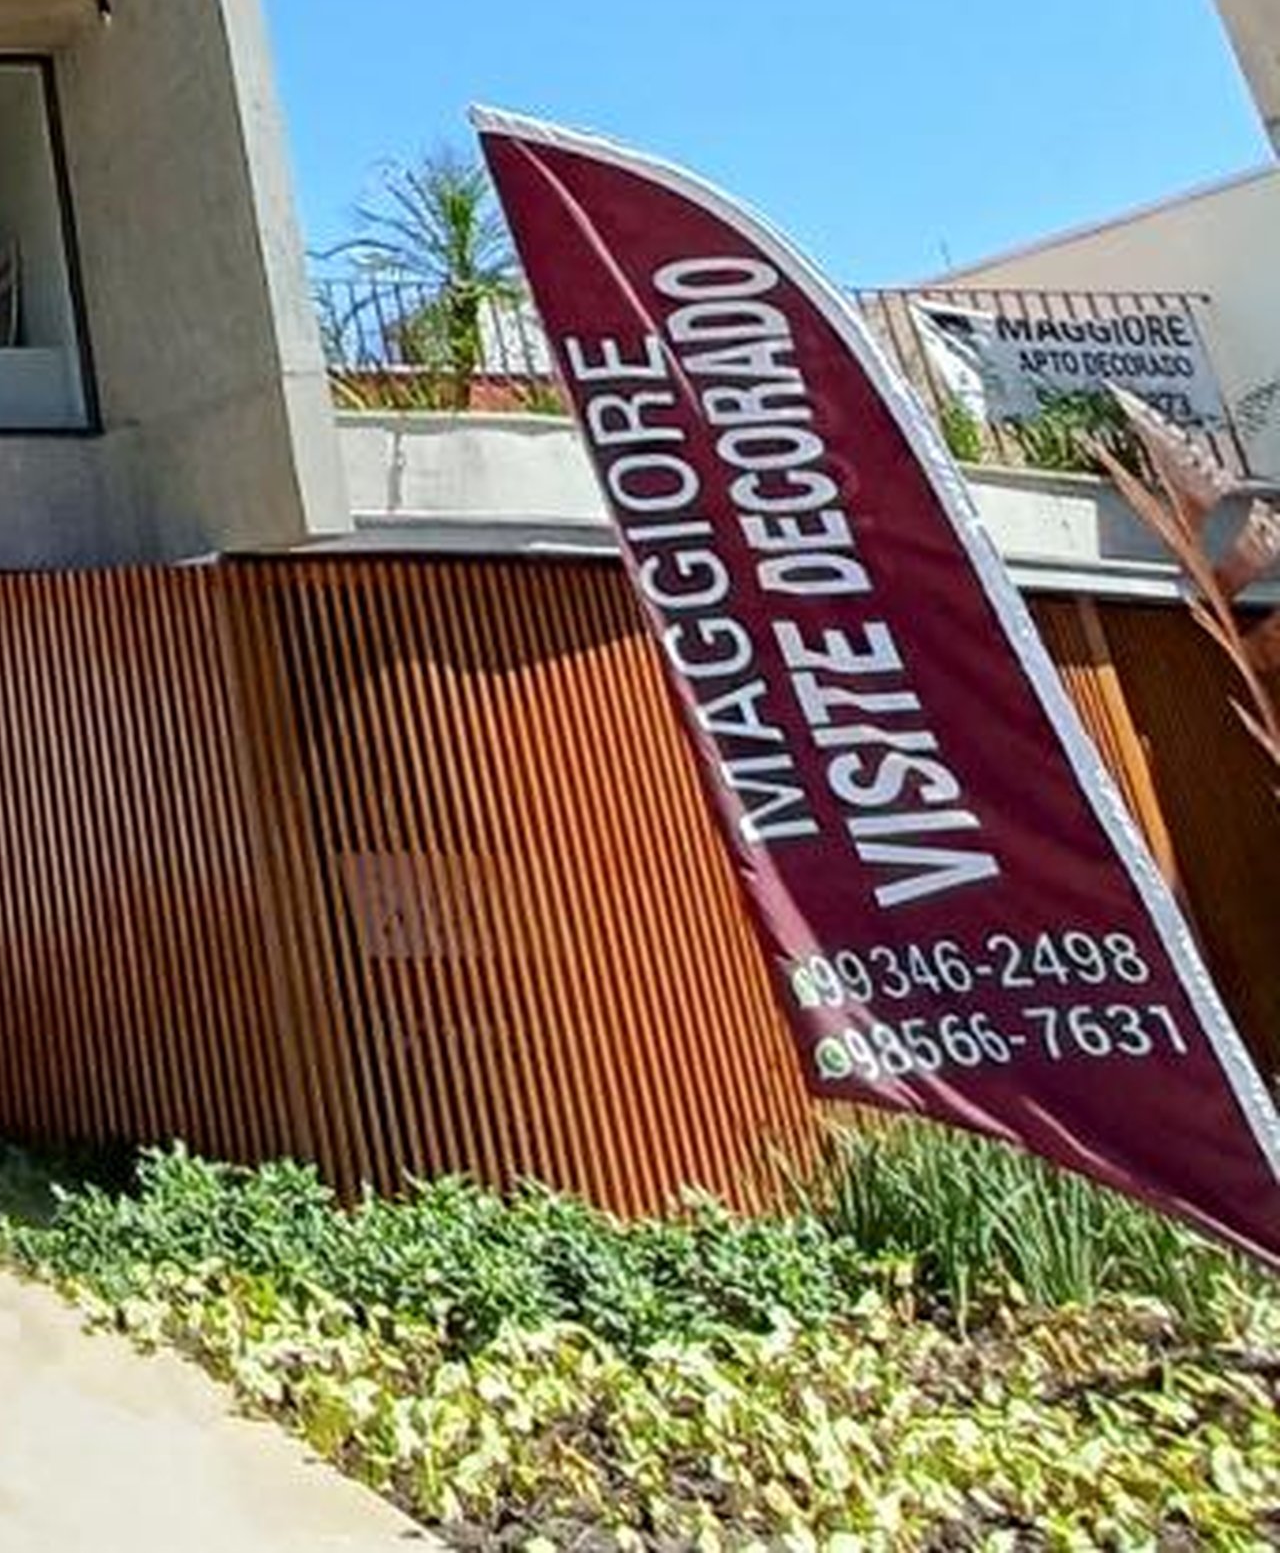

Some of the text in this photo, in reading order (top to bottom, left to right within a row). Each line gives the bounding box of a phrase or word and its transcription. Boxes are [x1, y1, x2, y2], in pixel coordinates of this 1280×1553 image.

[995, 314, 1193, 347] MAGGIORE
[1020, 350, 1080, 374] APTO
[568, 335, 821, 842] MAGGIORE
[653, 257, 1001, 909] VISITE DECORADO
[807, 931, 1150, 1006] 99346-2498
[844, 1004, 1188, 1081] 98566-7631
